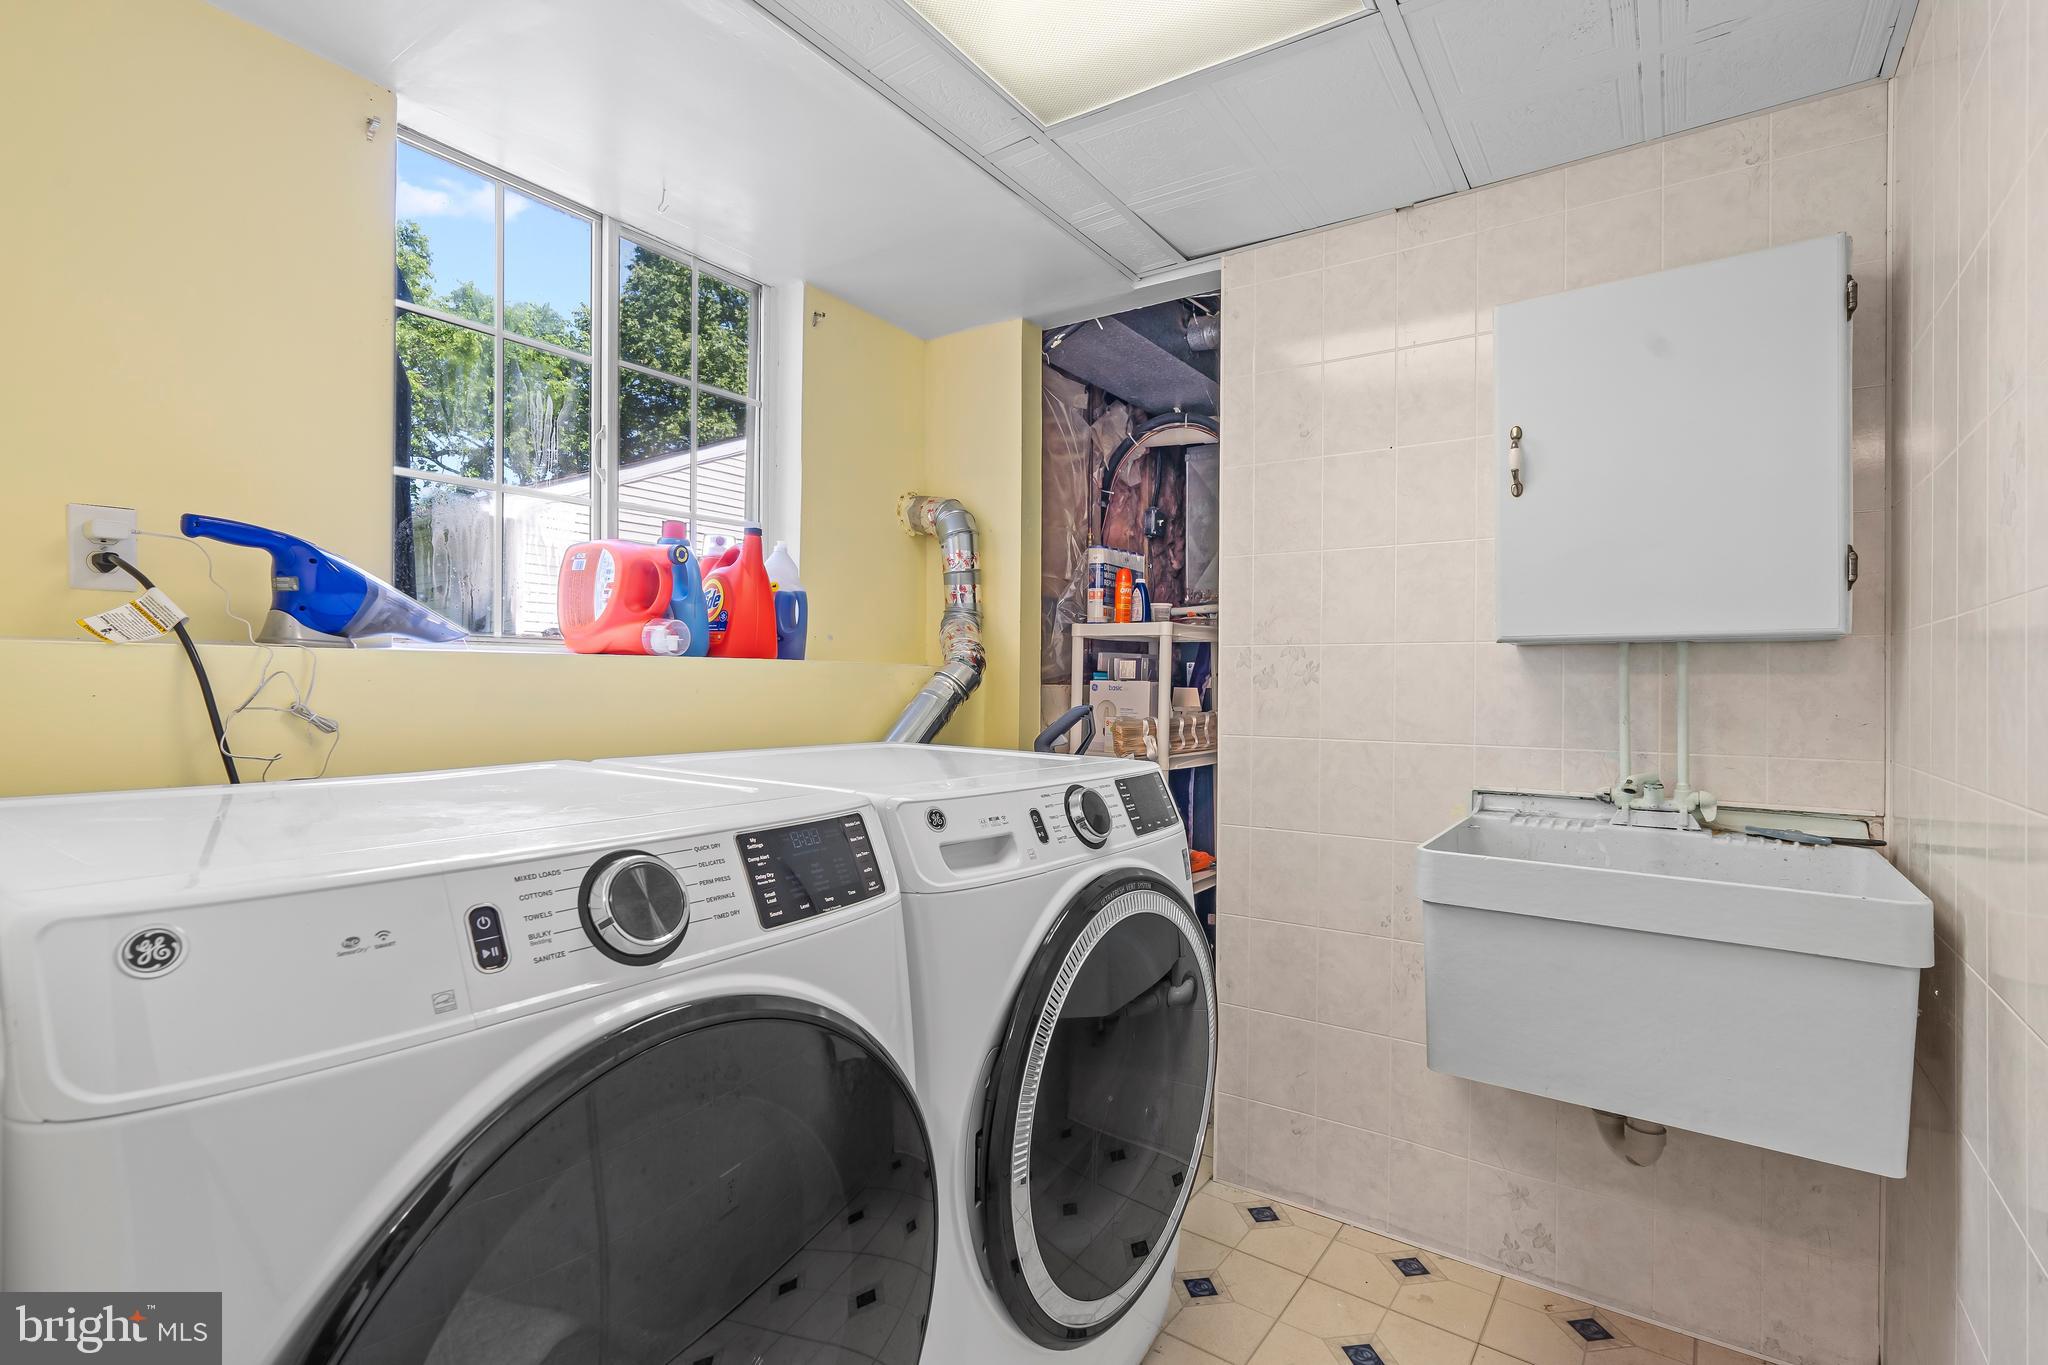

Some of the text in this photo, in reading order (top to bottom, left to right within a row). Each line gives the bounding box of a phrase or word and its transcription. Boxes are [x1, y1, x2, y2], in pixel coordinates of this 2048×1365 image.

[693, 845, 710, 853] QUICK
[698, 859, 725, 868] DELICATES
[514, 869, 561, 882] MIXED LOADS
[699, 875, 732, 887] PERM PRESS
[519, 890, 553, 901] COTTONS
[706, 892, 735, 903] DEWRINKLE
[523, 911, 552, 921] TOWELS
[713, 909, 741, 920] TIMED DRY
[528, 930, 551, 940] BULKY
[533, 951, 566, 963] SANITIZE
